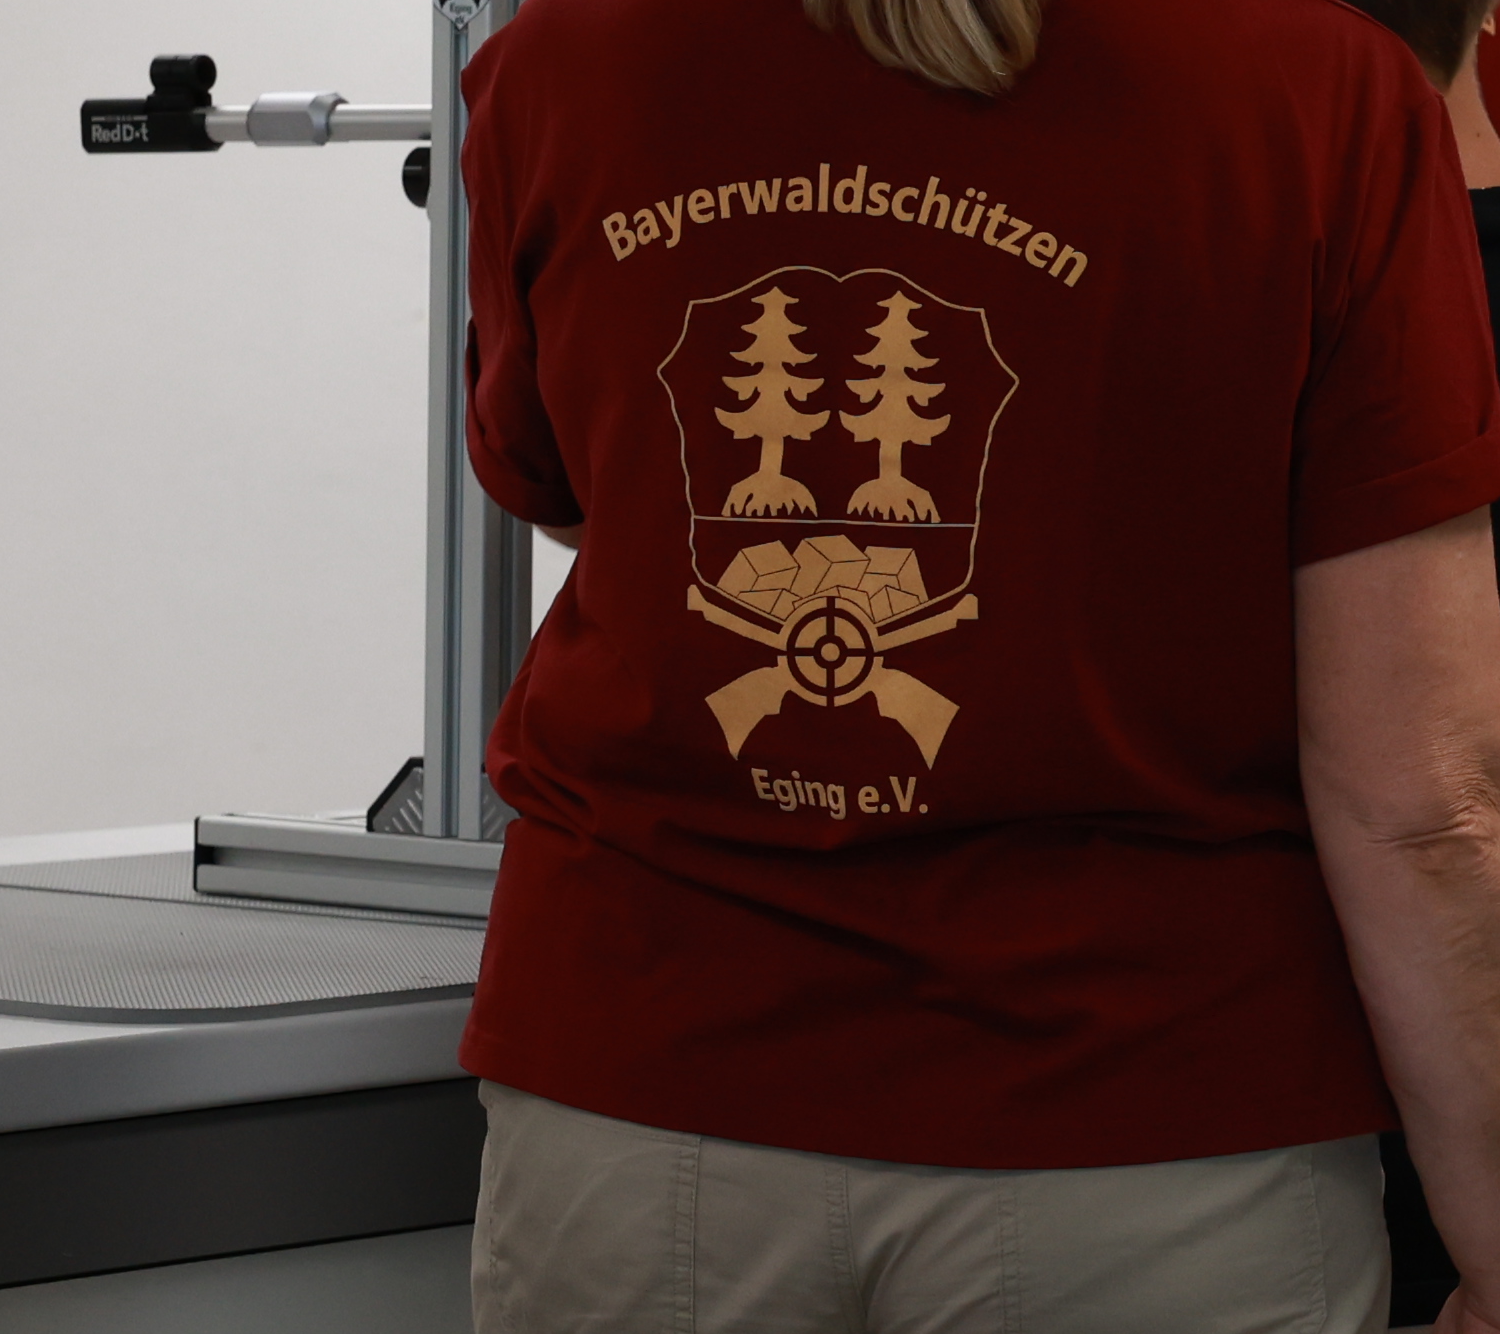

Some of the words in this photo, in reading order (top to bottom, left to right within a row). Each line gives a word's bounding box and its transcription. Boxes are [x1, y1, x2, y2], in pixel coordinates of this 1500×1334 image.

[602, 162, 1088, 287] Bayerwaldschützen
[751, 767, 847, 820] Eging
[857, 776, 929, 814] e.V.
